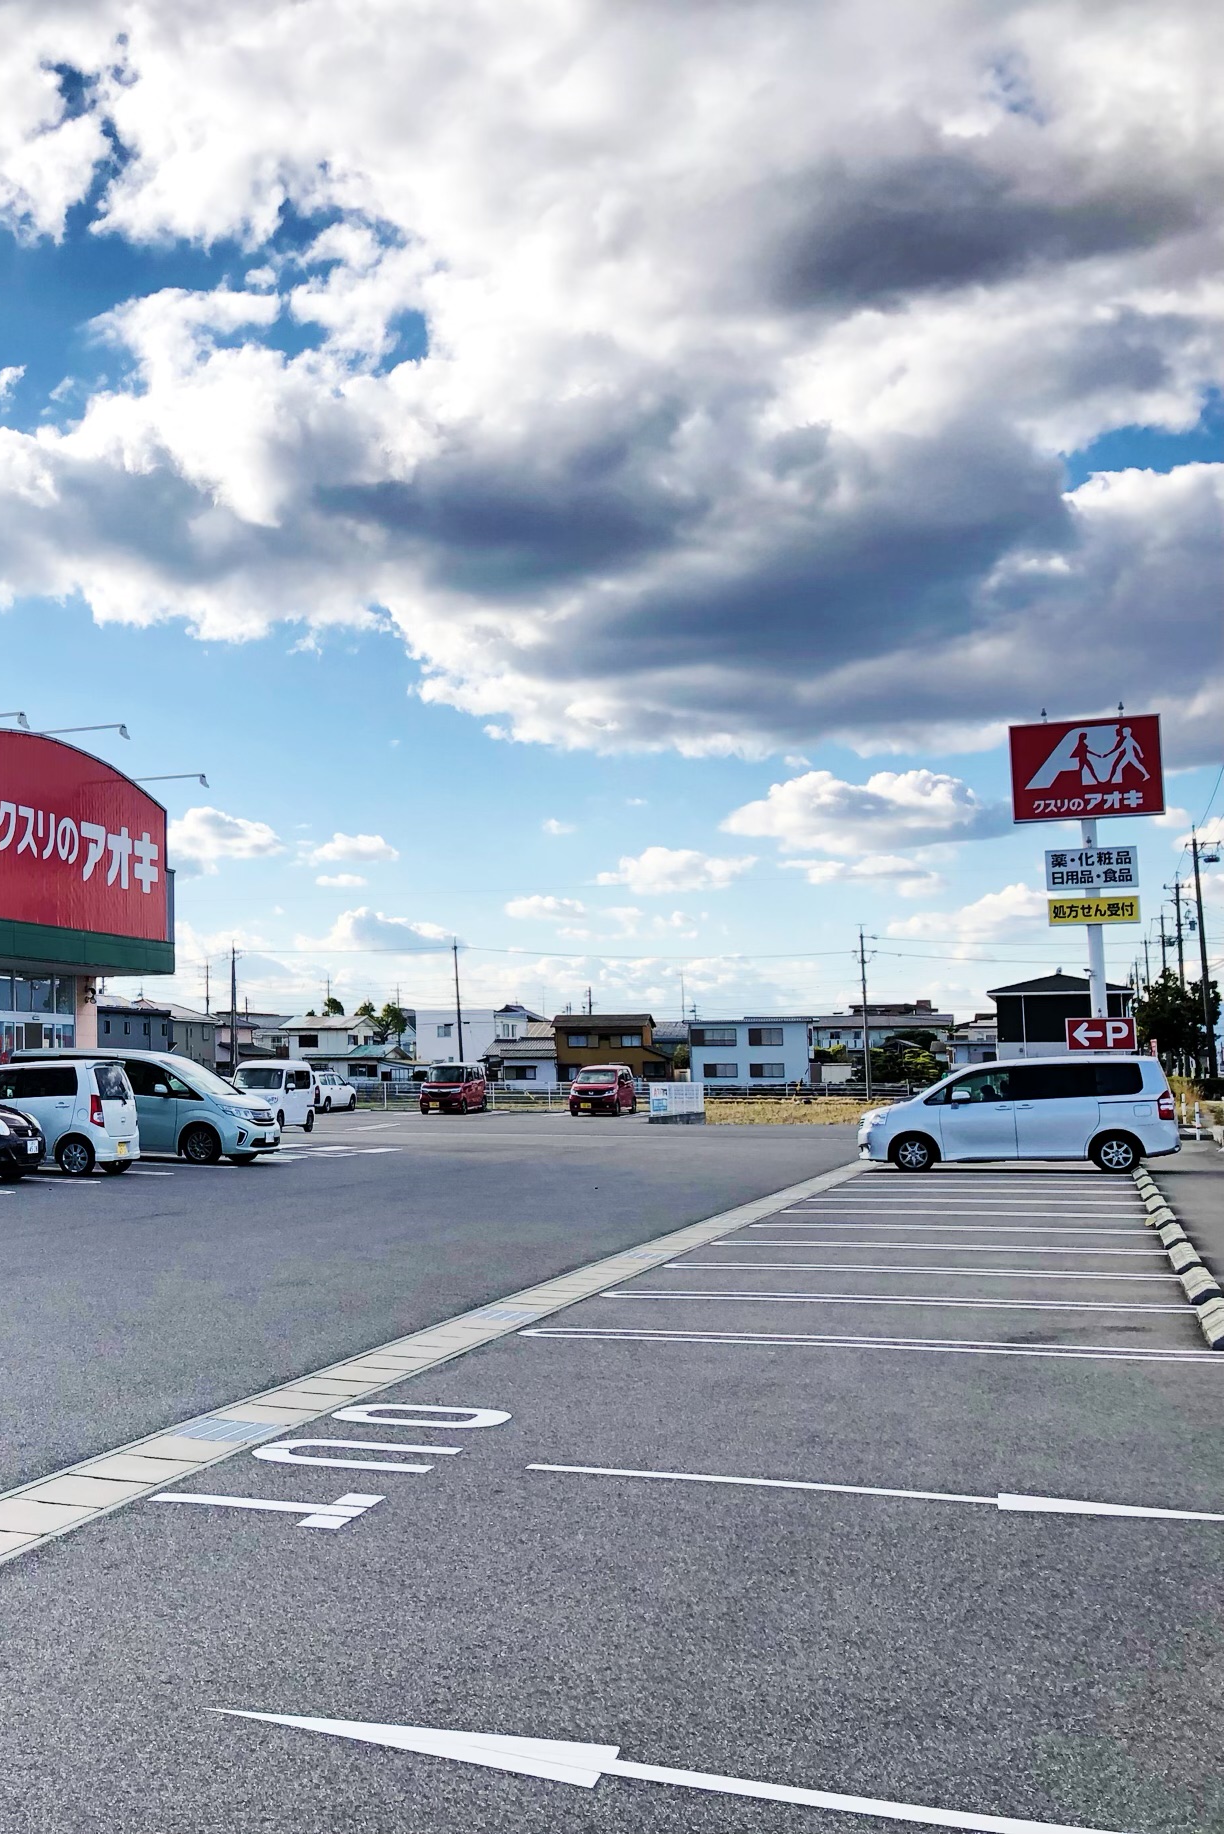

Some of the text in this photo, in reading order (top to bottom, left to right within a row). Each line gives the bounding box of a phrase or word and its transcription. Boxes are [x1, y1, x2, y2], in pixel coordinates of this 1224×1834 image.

[1032, 789, 1144, 813] クスリのアオキ
[1050, 850, 1132, 868] 薬・化粧品
[1051, 868, 1133, 885] 日用品・食品
[1052, 902, 1135, 919] 処方せん受付
[1106, 1021, 1129, 1047] P
[147, 1403, 513, 1529] OUT
